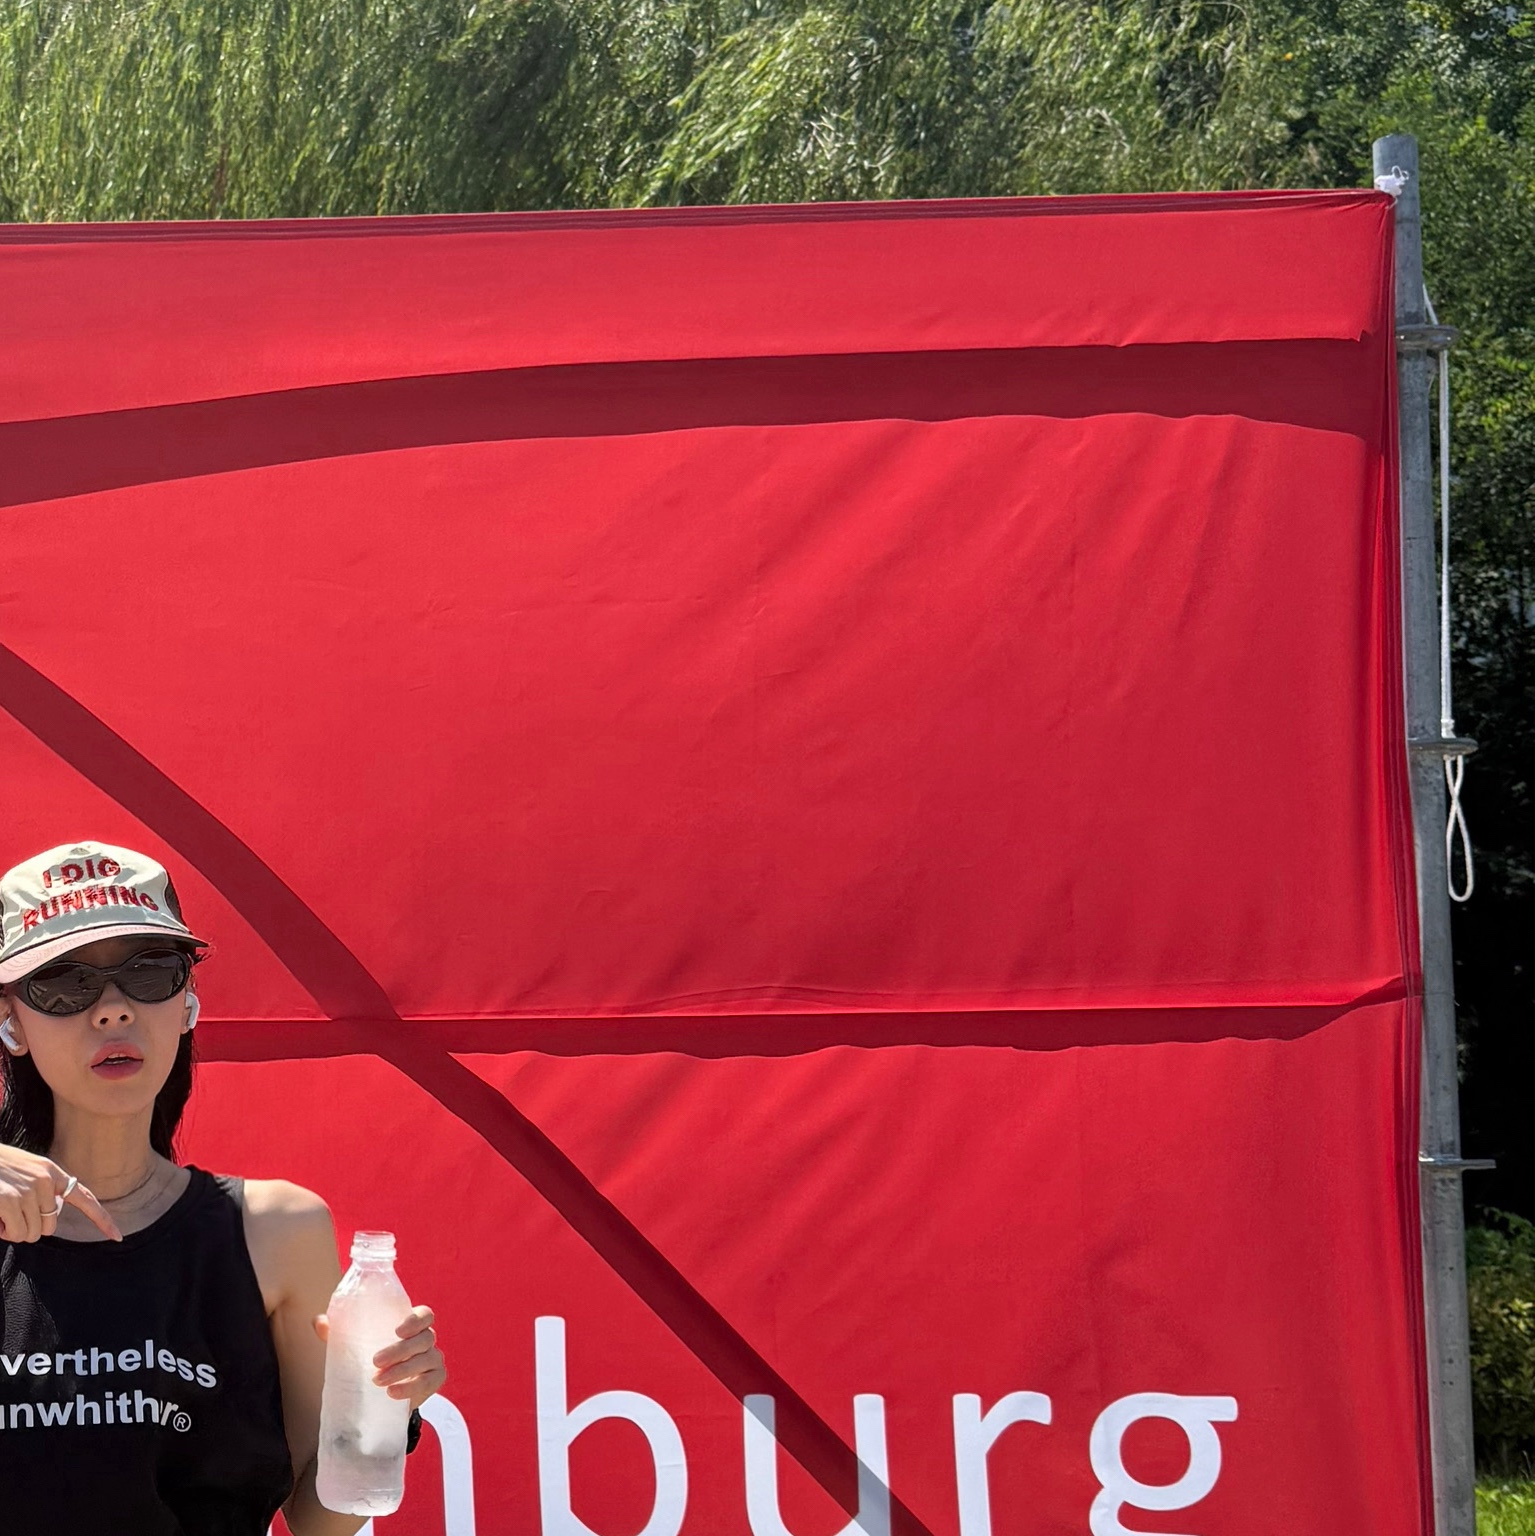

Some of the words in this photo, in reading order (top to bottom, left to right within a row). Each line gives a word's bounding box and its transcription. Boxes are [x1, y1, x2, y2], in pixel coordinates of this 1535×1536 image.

[43, 869, 52, 888] I
[61, 857, 121, 885] DIG
[22, 885, 159, 934] RUNNING
